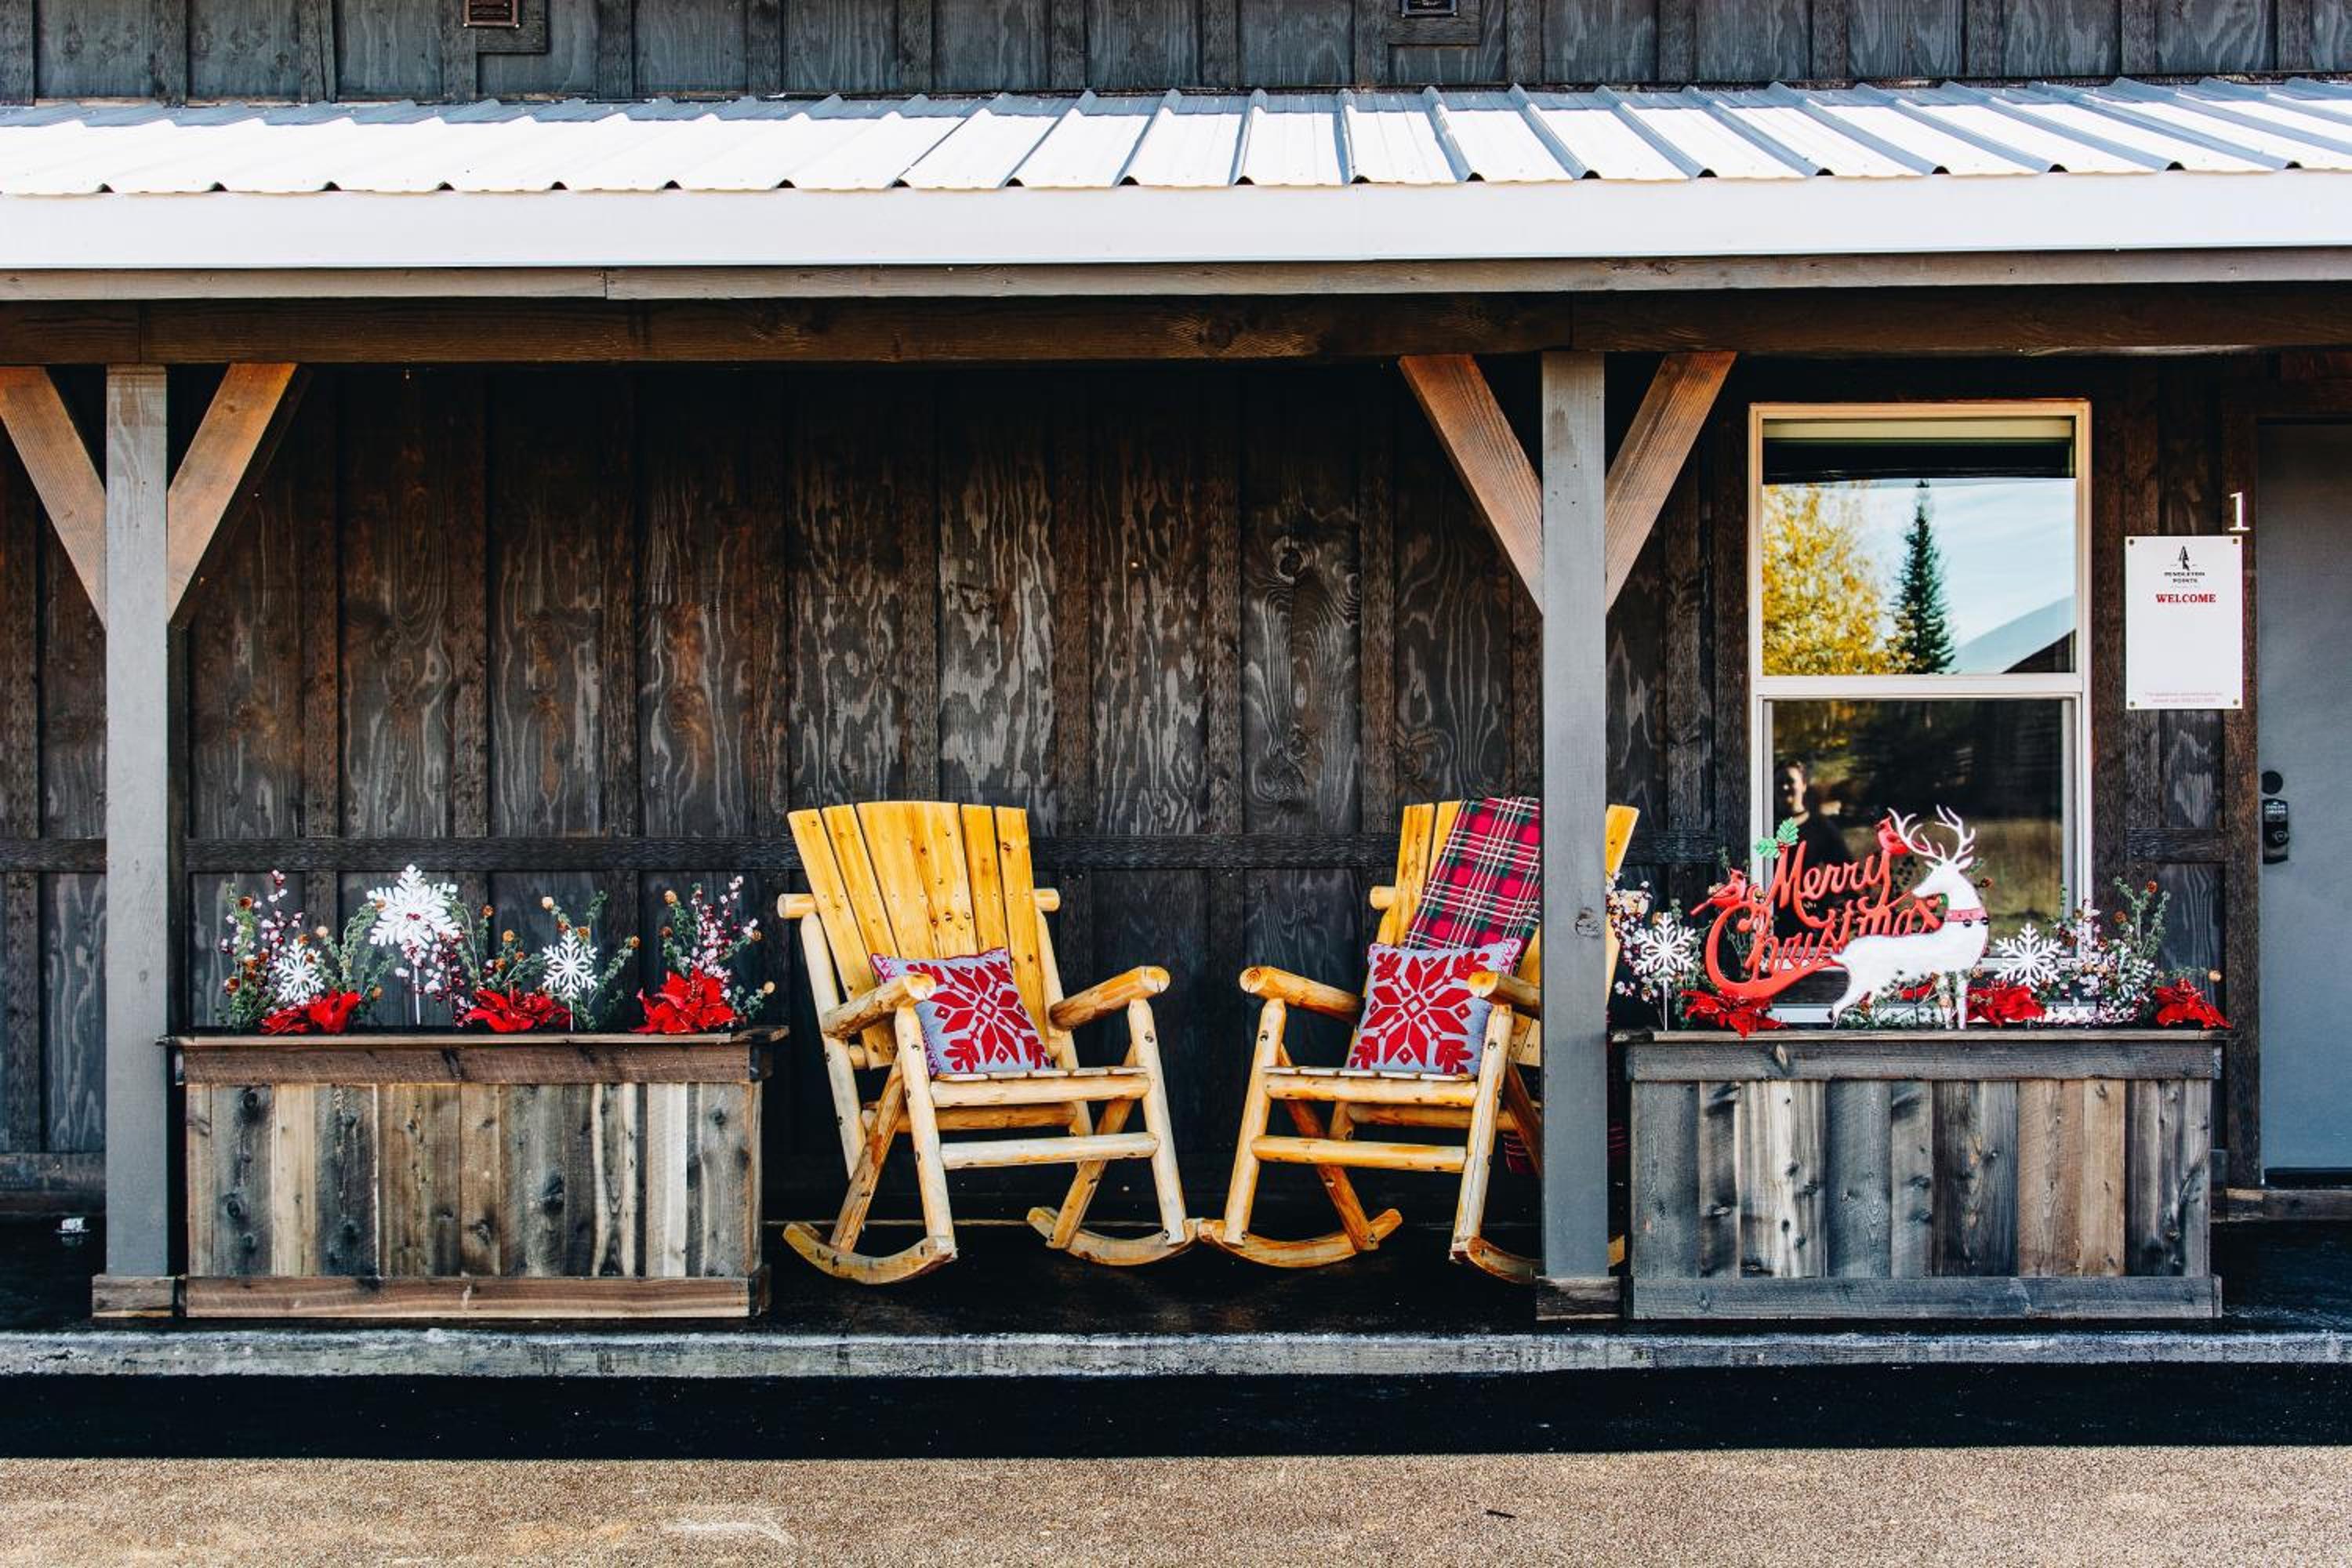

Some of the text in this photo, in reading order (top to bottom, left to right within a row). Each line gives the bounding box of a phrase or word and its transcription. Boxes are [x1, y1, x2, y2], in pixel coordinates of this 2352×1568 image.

[2229, 492, 2250, 531] 1
[2156, 593, 2216, 603] WELCOME
[1764, 840, 1893, 930] Merry
